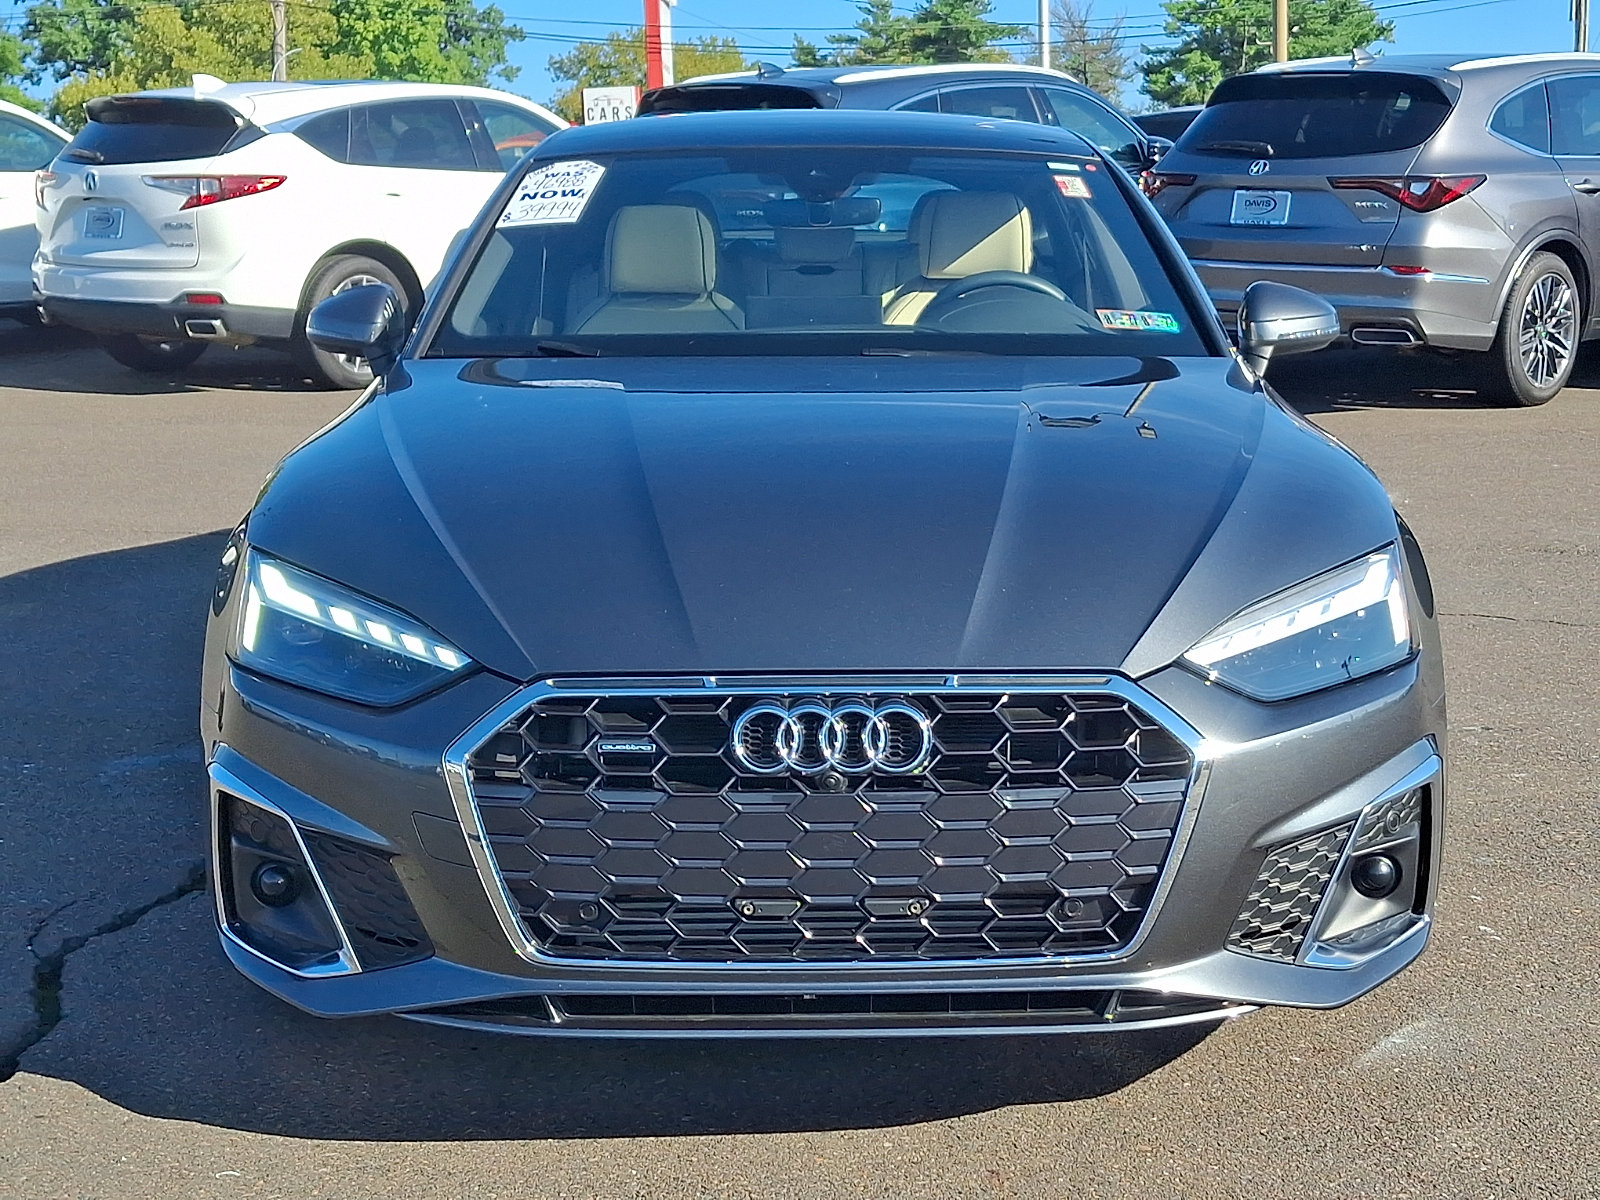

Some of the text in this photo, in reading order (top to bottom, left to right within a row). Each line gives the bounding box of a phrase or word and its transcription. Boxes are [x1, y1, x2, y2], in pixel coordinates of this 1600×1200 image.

[587, 106, 632, 121] CARS
[519, 189, 584, 201] NOW
[1244, 199, 1272, 207] DAVIS
